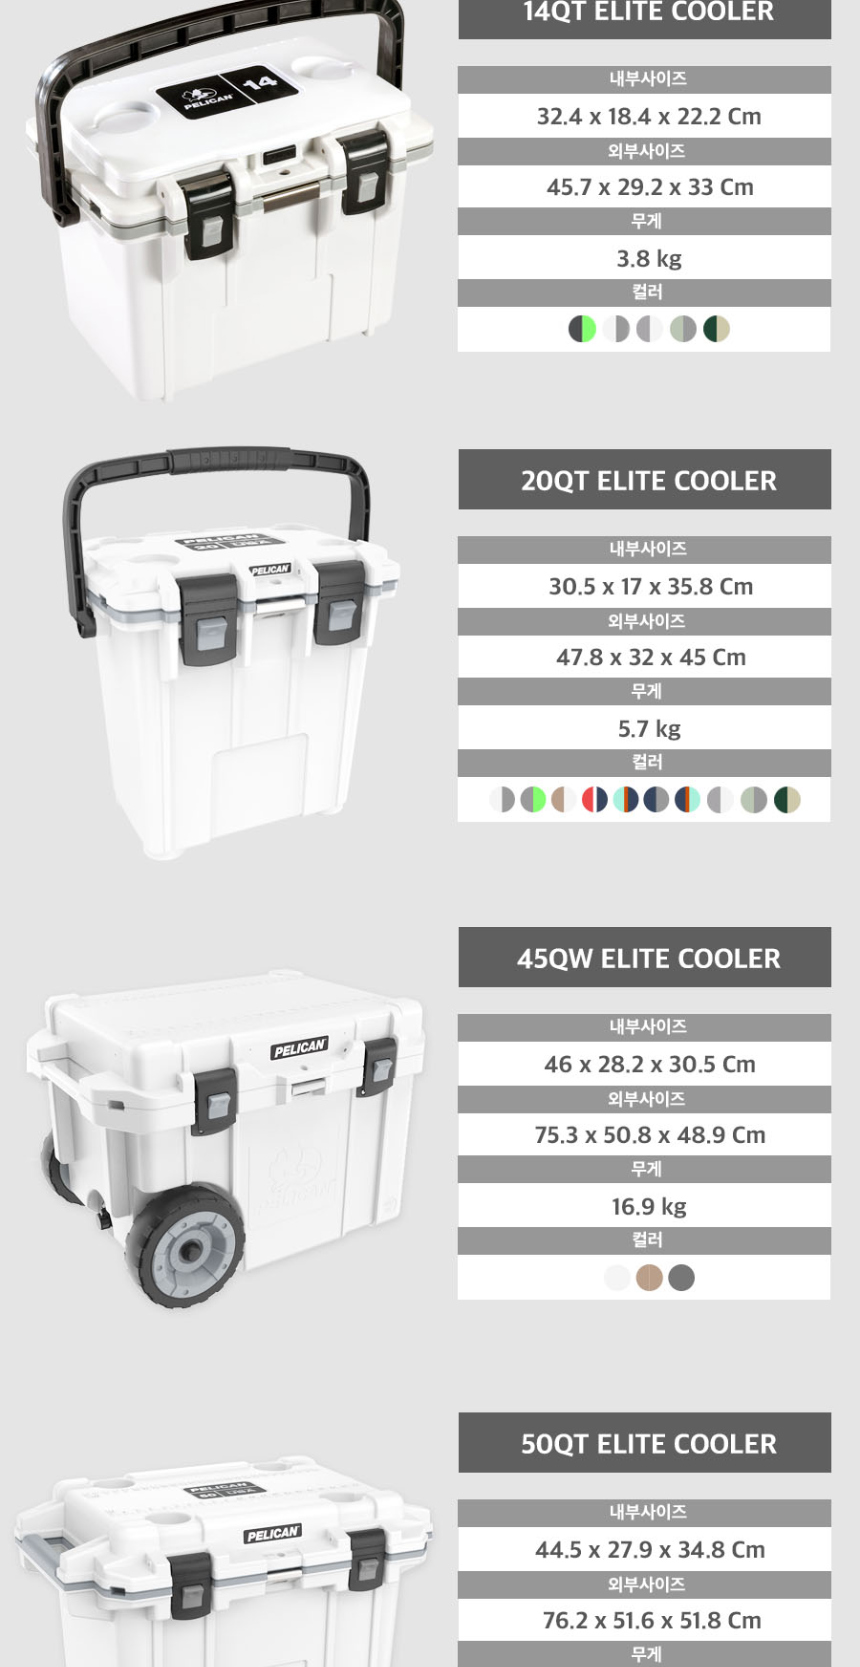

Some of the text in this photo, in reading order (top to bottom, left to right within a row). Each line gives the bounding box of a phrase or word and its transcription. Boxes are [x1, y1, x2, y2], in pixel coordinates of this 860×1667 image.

[243, 76, 278, 91] 14
[184, 94, 233, 110] PELICAN
[251, 564, 290, 575] PELICAN
[274, 1039, 324, 1058] PELICAN
[191, 1482, 247, 1493] PELICAN
[248, 1527, 298, 1542] PELICAN
